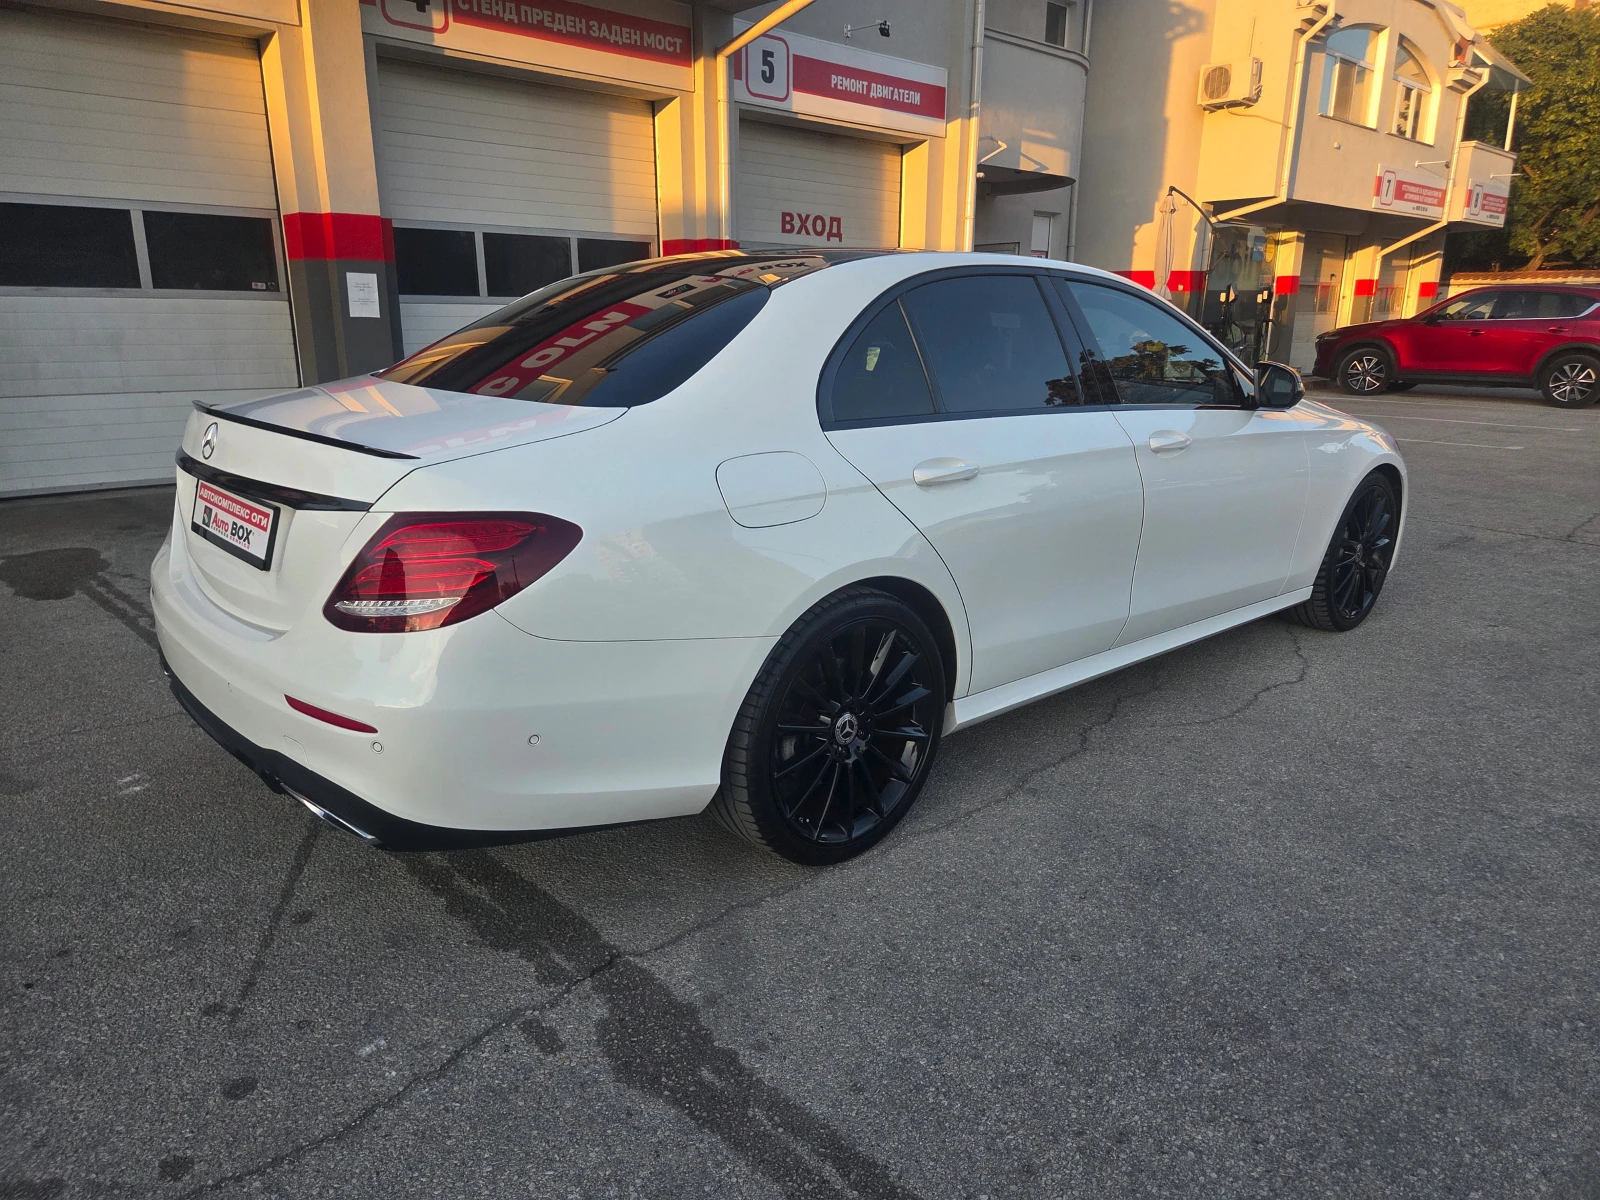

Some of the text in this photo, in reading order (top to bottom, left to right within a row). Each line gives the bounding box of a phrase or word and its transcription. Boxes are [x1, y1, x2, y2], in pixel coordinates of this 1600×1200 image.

[457, 0, 518, 24] СТЕНД
[521, 6, 586, 35] ПРЕДЕН
[589, 20, 641, 46] ЗАДЕН
[643, 32, 683, 54] МОСТ
[761, 49, 775, 84] 5
[831, 74, 921, 106] РЕМОНТ ДВИГАТЕЛИ
[1385, 179, 1392, 197] 7
[781, 211, 843, 242] ВХОД
[199, 487, 268, 528] АВТОКОМПЛЕКС ОГИ
[230, 521, 253, 545] BOX
